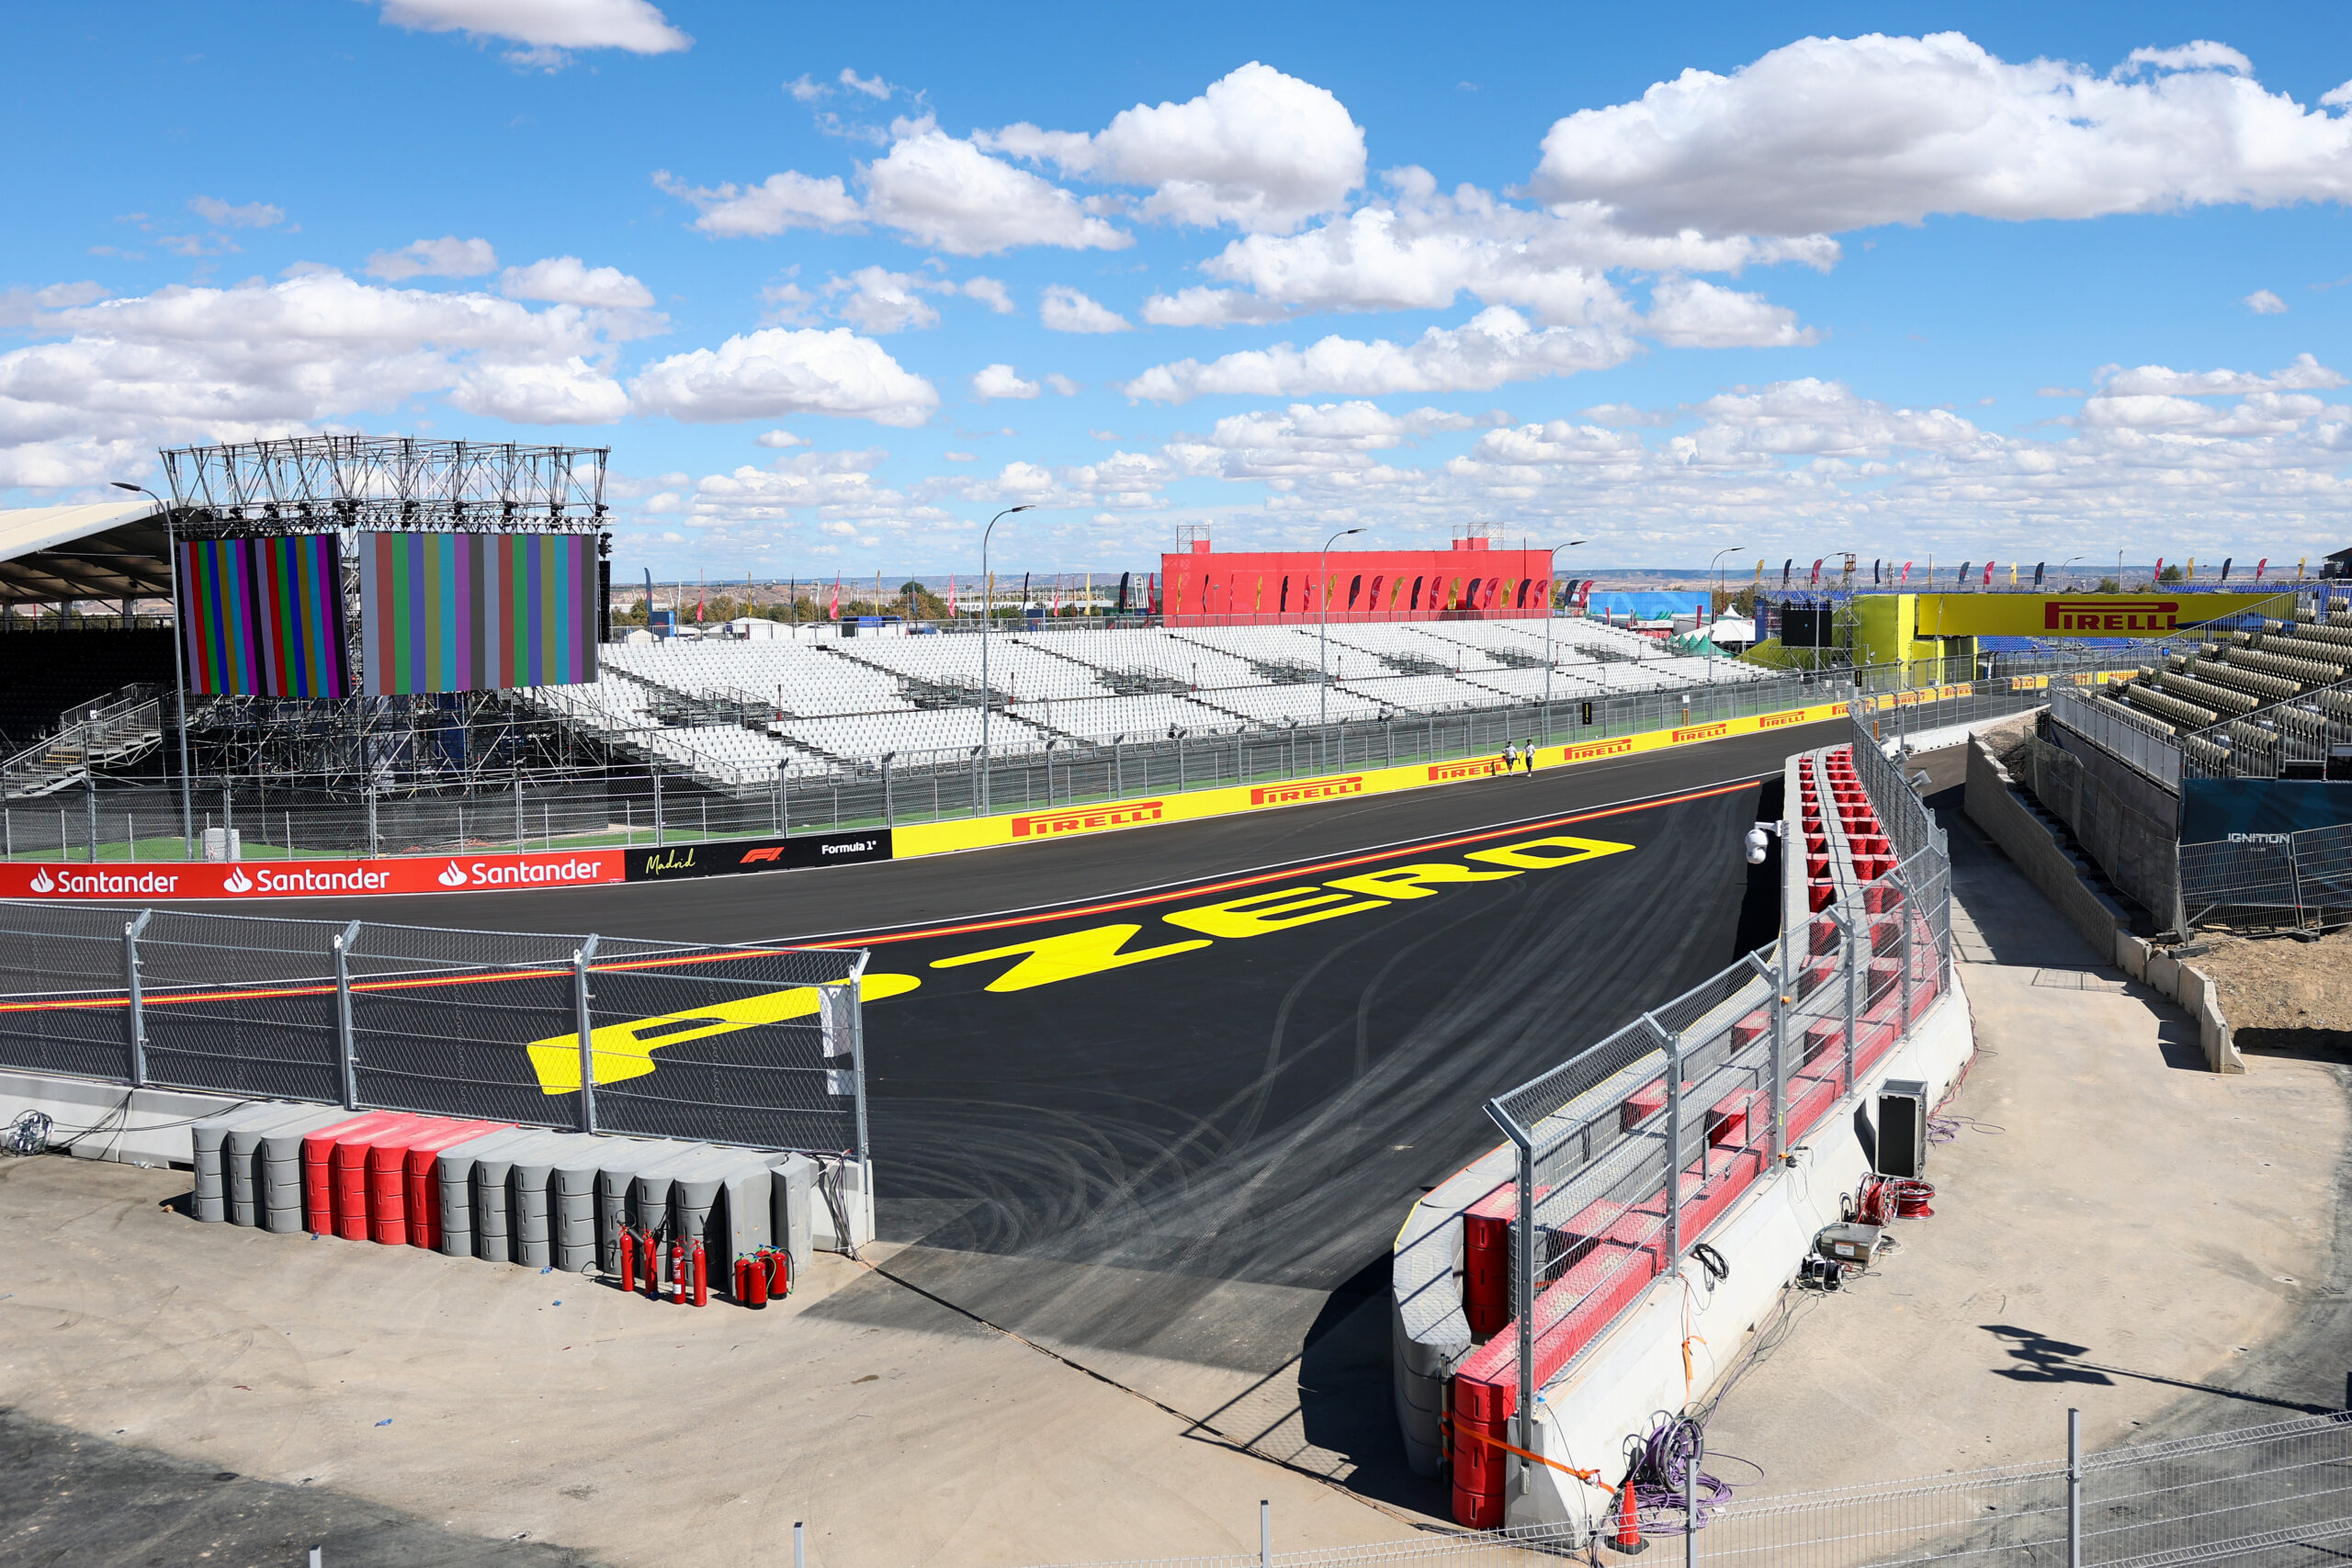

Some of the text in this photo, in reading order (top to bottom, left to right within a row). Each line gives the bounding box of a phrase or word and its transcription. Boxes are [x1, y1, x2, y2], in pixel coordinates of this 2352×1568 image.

[2045, 602, 2178, 630] PIRELLI
[1760, 711, 1804, 728] PIRELLI
[1672, 724, 1726, 742] PIRELLI
[1565, 739, 1632, 760] PIRELLI
[1429, 758, 1507, 781] PIRELL
[1250, 776, 1362, 806] PIRELLI
[1012, 801, 1163, 837] PIRELLI
[821, 842, 865, 854] Formula
[2228, 833, 2290, 843] IGNITION
[471, 859, 601, 885] Santander
[646, 848, 695, 874] Madrid
[58, 871, 178, 893] Santander
[257, 868, 390, 892] Santander
[526, 836, 1635, 1096] P ZERO
